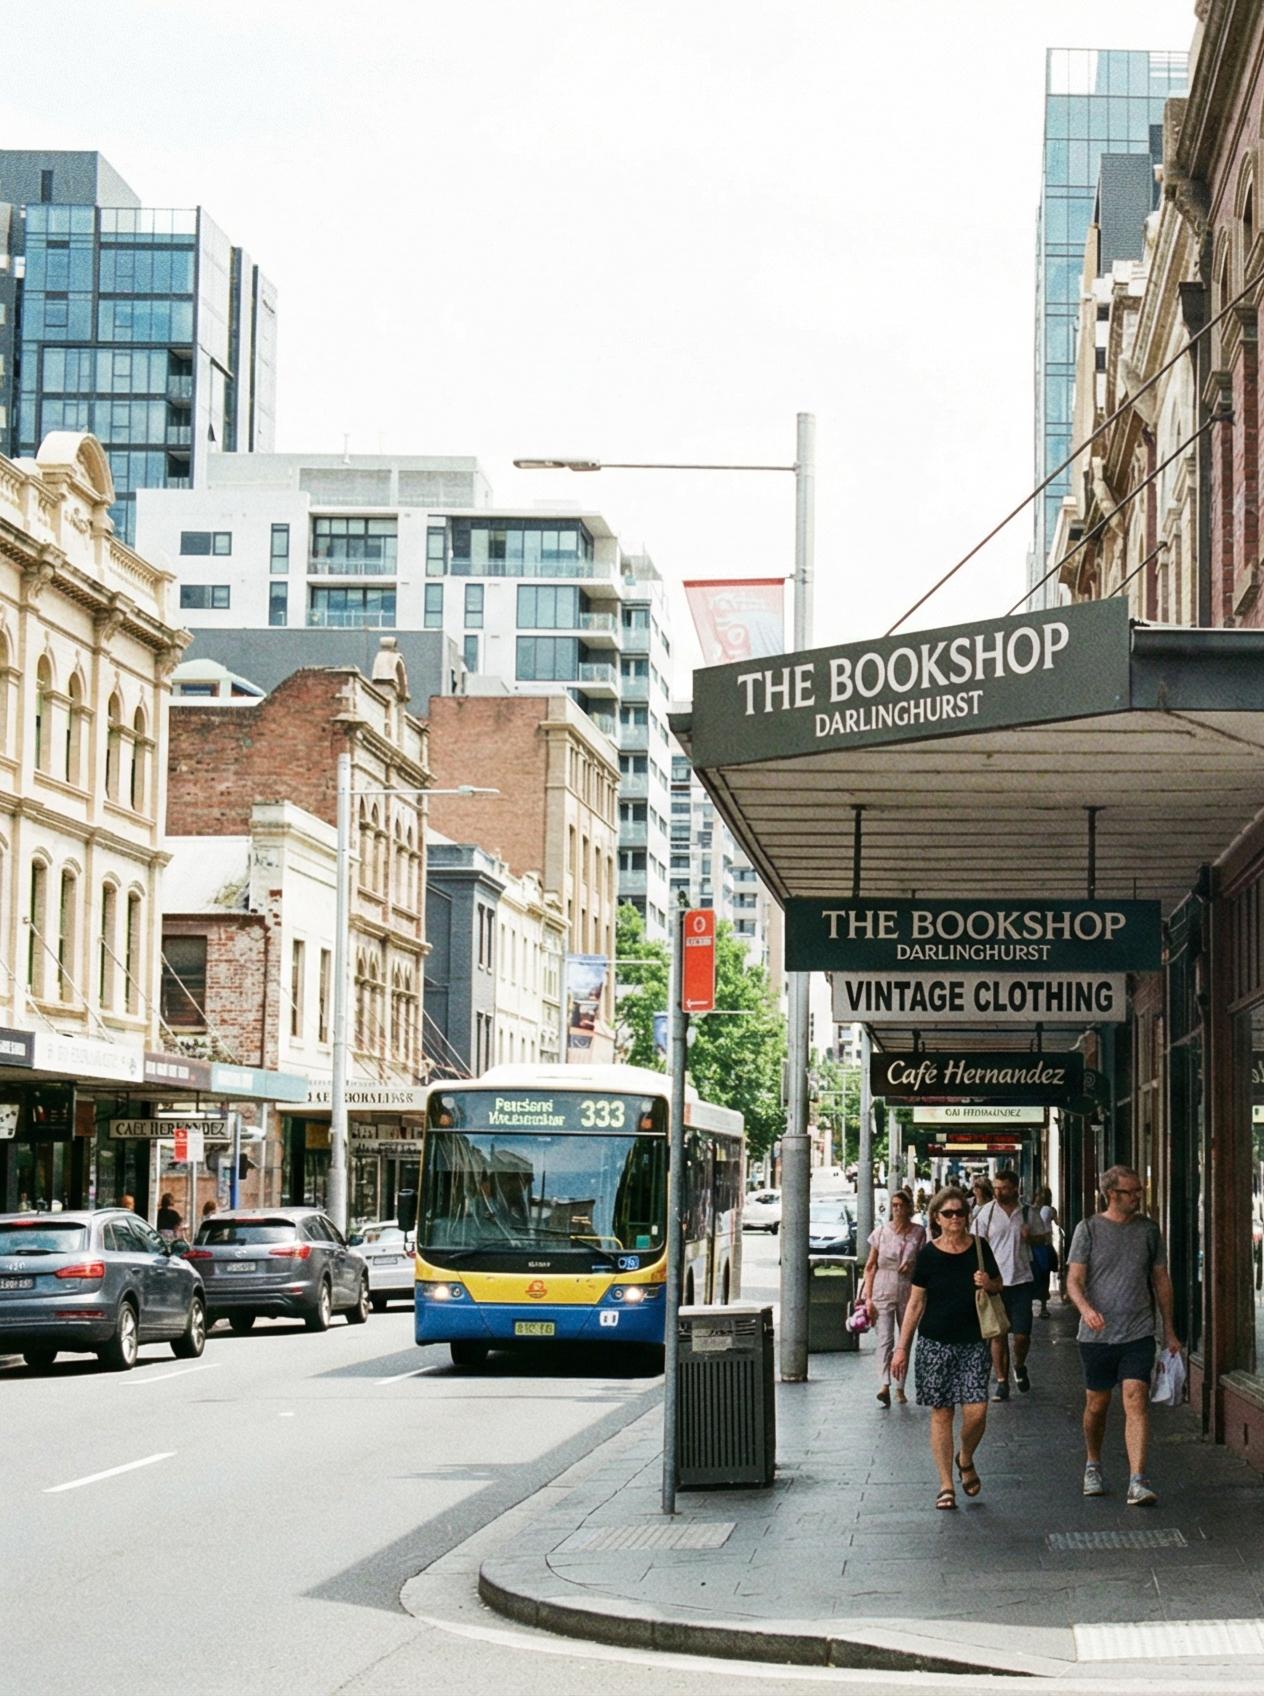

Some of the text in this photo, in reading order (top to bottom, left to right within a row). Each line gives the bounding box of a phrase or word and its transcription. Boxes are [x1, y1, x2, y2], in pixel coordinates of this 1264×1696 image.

[737, 621, 1069, 716] THE BOOKSHOP
[815, 690, 984, 737] DARLINGHURST
[821, 910, 1126, 940] THE BOOKSHOP
[896, 944, 1051, 960] DARLINGHURST
[845, 980, 1113, 1012] VINTAGE CLOTHING
[887, 1060, 1065, 1091] Café Hernandez
[580, 1100, 625, 1128] 333
